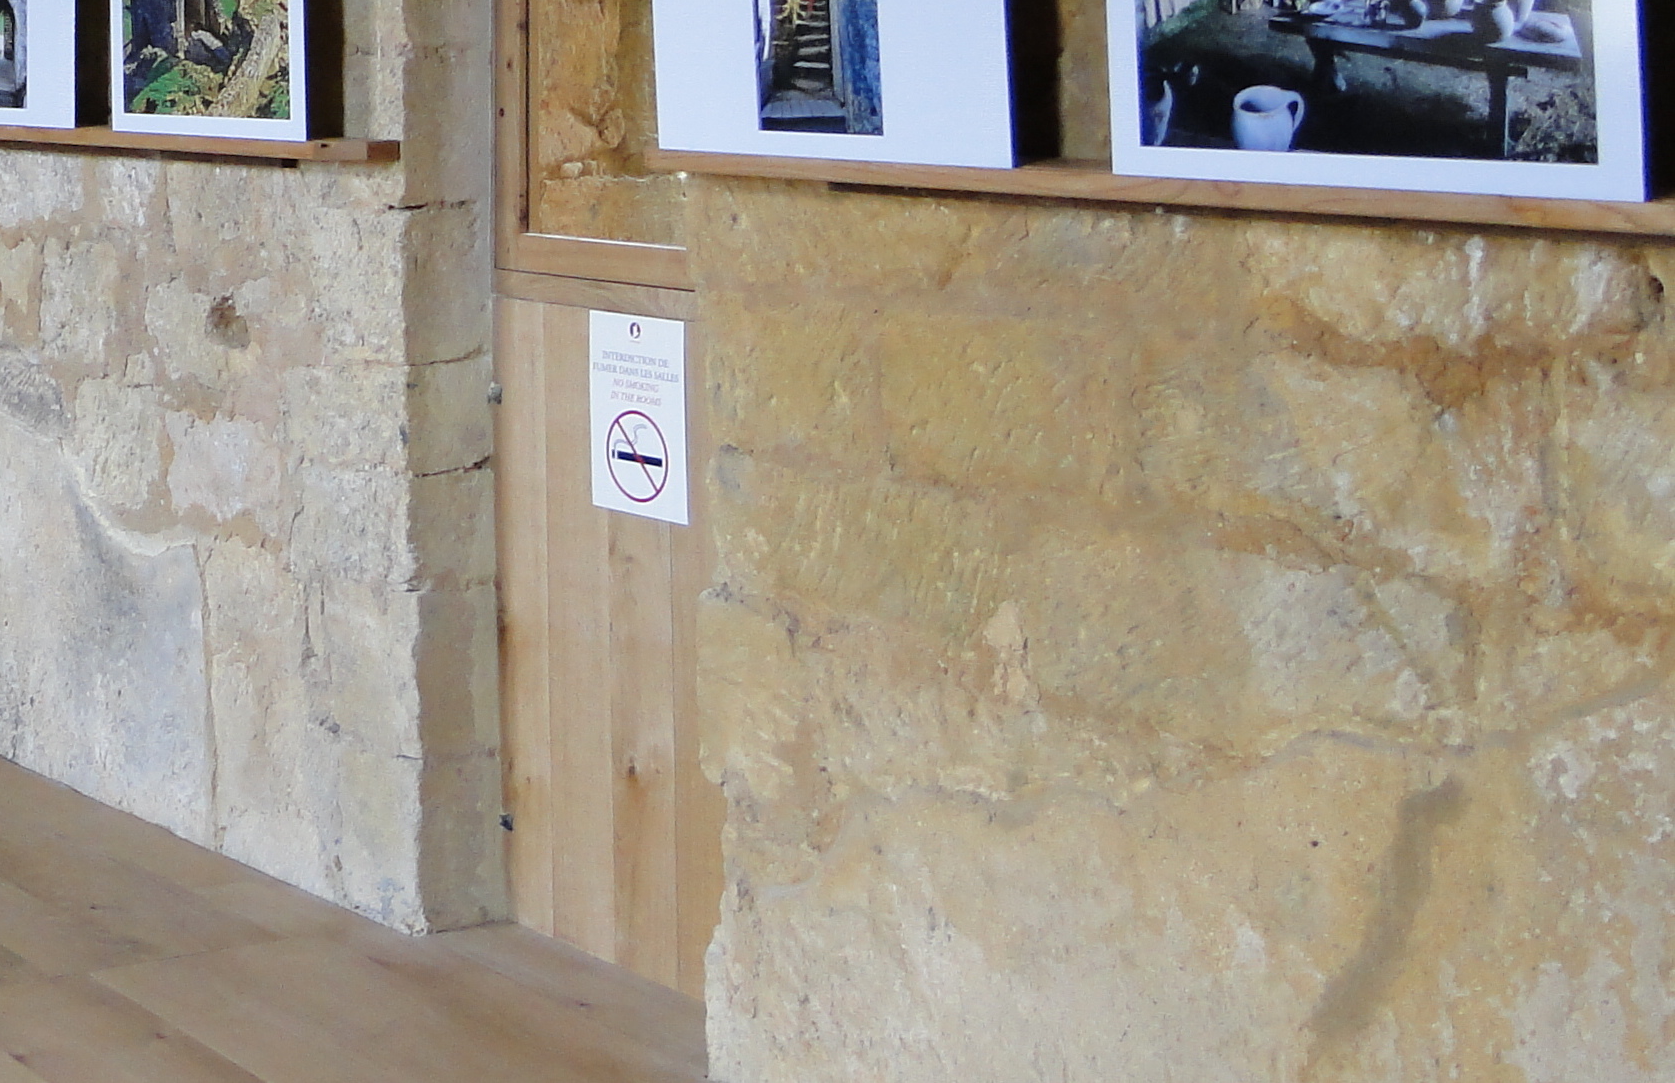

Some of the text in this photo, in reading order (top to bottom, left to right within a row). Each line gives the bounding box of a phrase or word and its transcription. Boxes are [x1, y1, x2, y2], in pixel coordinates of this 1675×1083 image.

[602, 350, 669, 368] INTERDICTION DE
[592, 362, 679, 383] FUMER DANS LES SALLES
[613, 378, 660, 393] NO SMOKING
[610, 390, 662, 407] IN THE ROOMS
